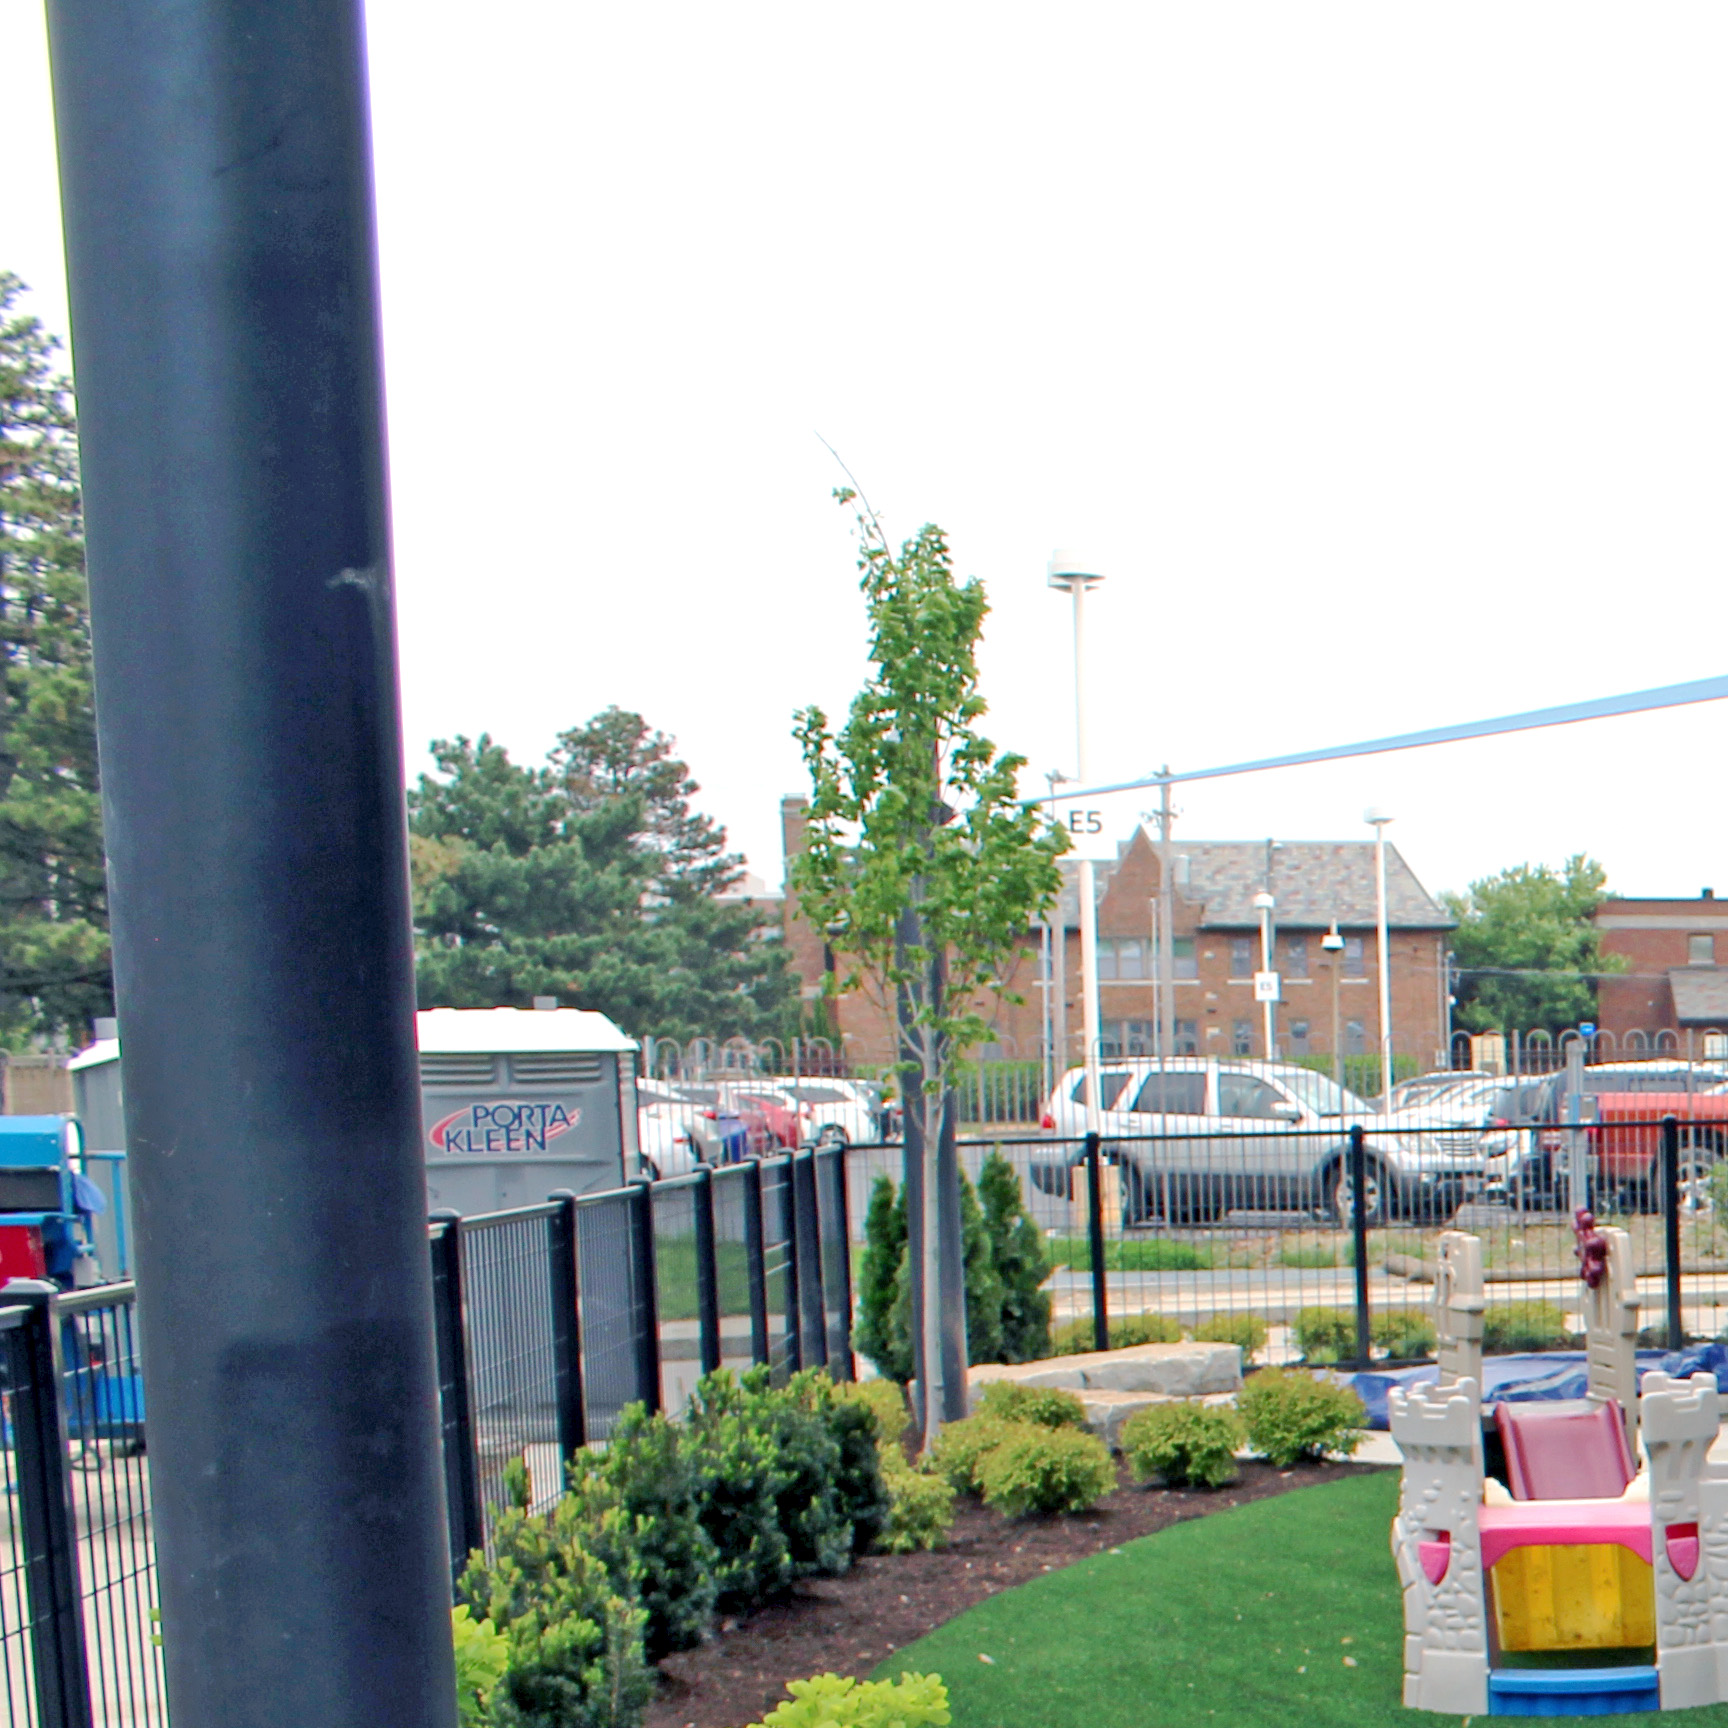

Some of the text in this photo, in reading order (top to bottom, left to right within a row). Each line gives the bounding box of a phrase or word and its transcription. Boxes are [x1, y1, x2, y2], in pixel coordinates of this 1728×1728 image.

[1070, 810, 1103, 834] E5
[472, 1104, 570, 1128] PORTA
[445, 1128, 546, 1152] KLEEN
